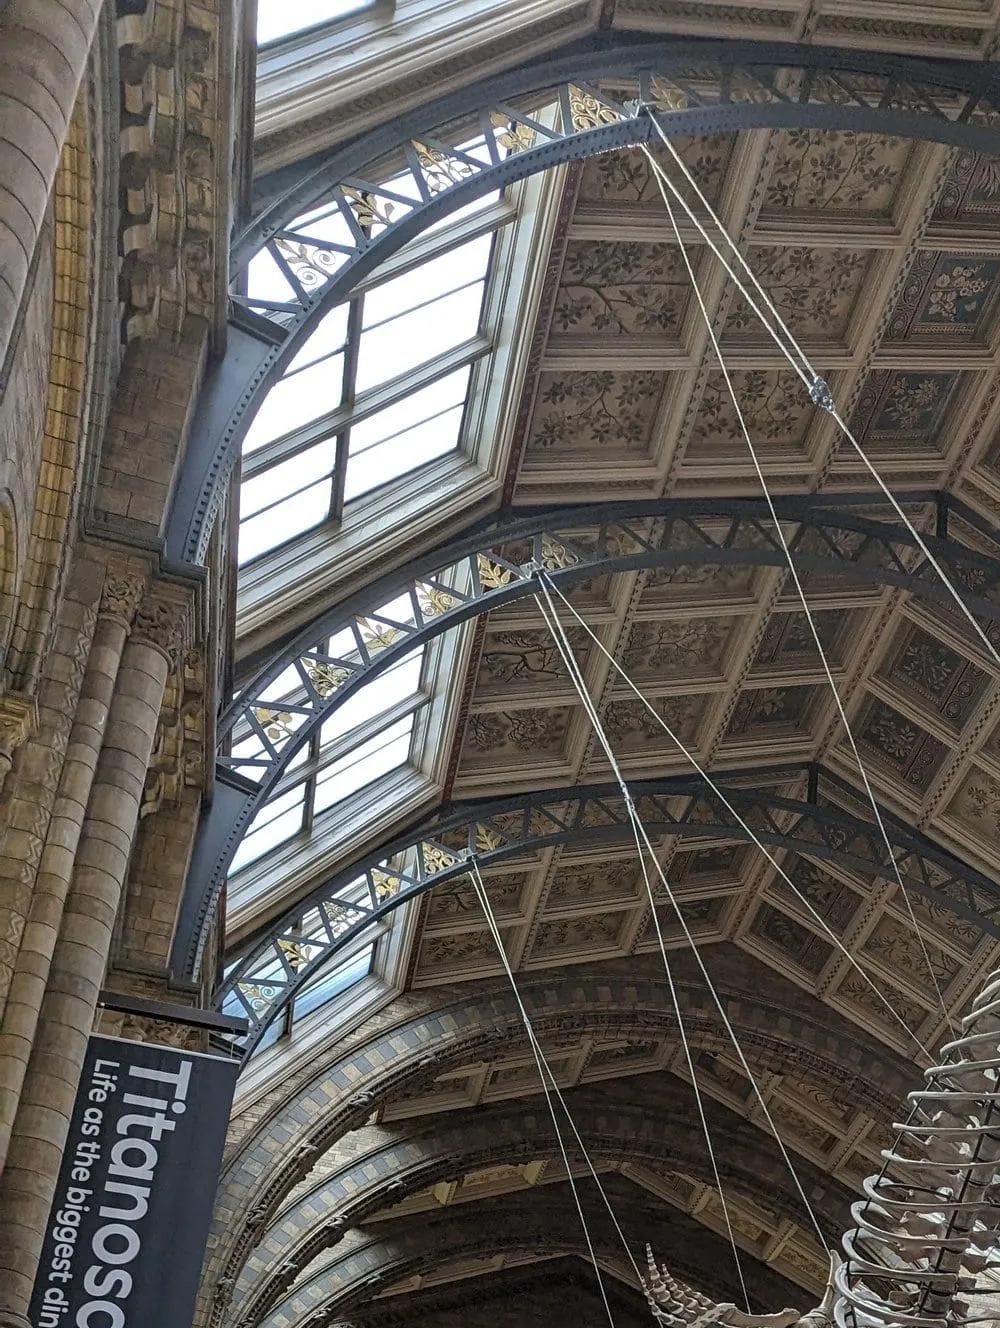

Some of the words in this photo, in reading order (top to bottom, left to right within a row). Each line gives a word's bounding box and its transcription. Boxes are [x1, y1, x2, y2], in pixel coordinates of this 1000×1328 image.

[88, 1058, 120, 1103] Life
[81, 1107, 103, 1137] as
[71, 1141, 101, 1182] the
[48, 1186, 93, 1283] biggest
